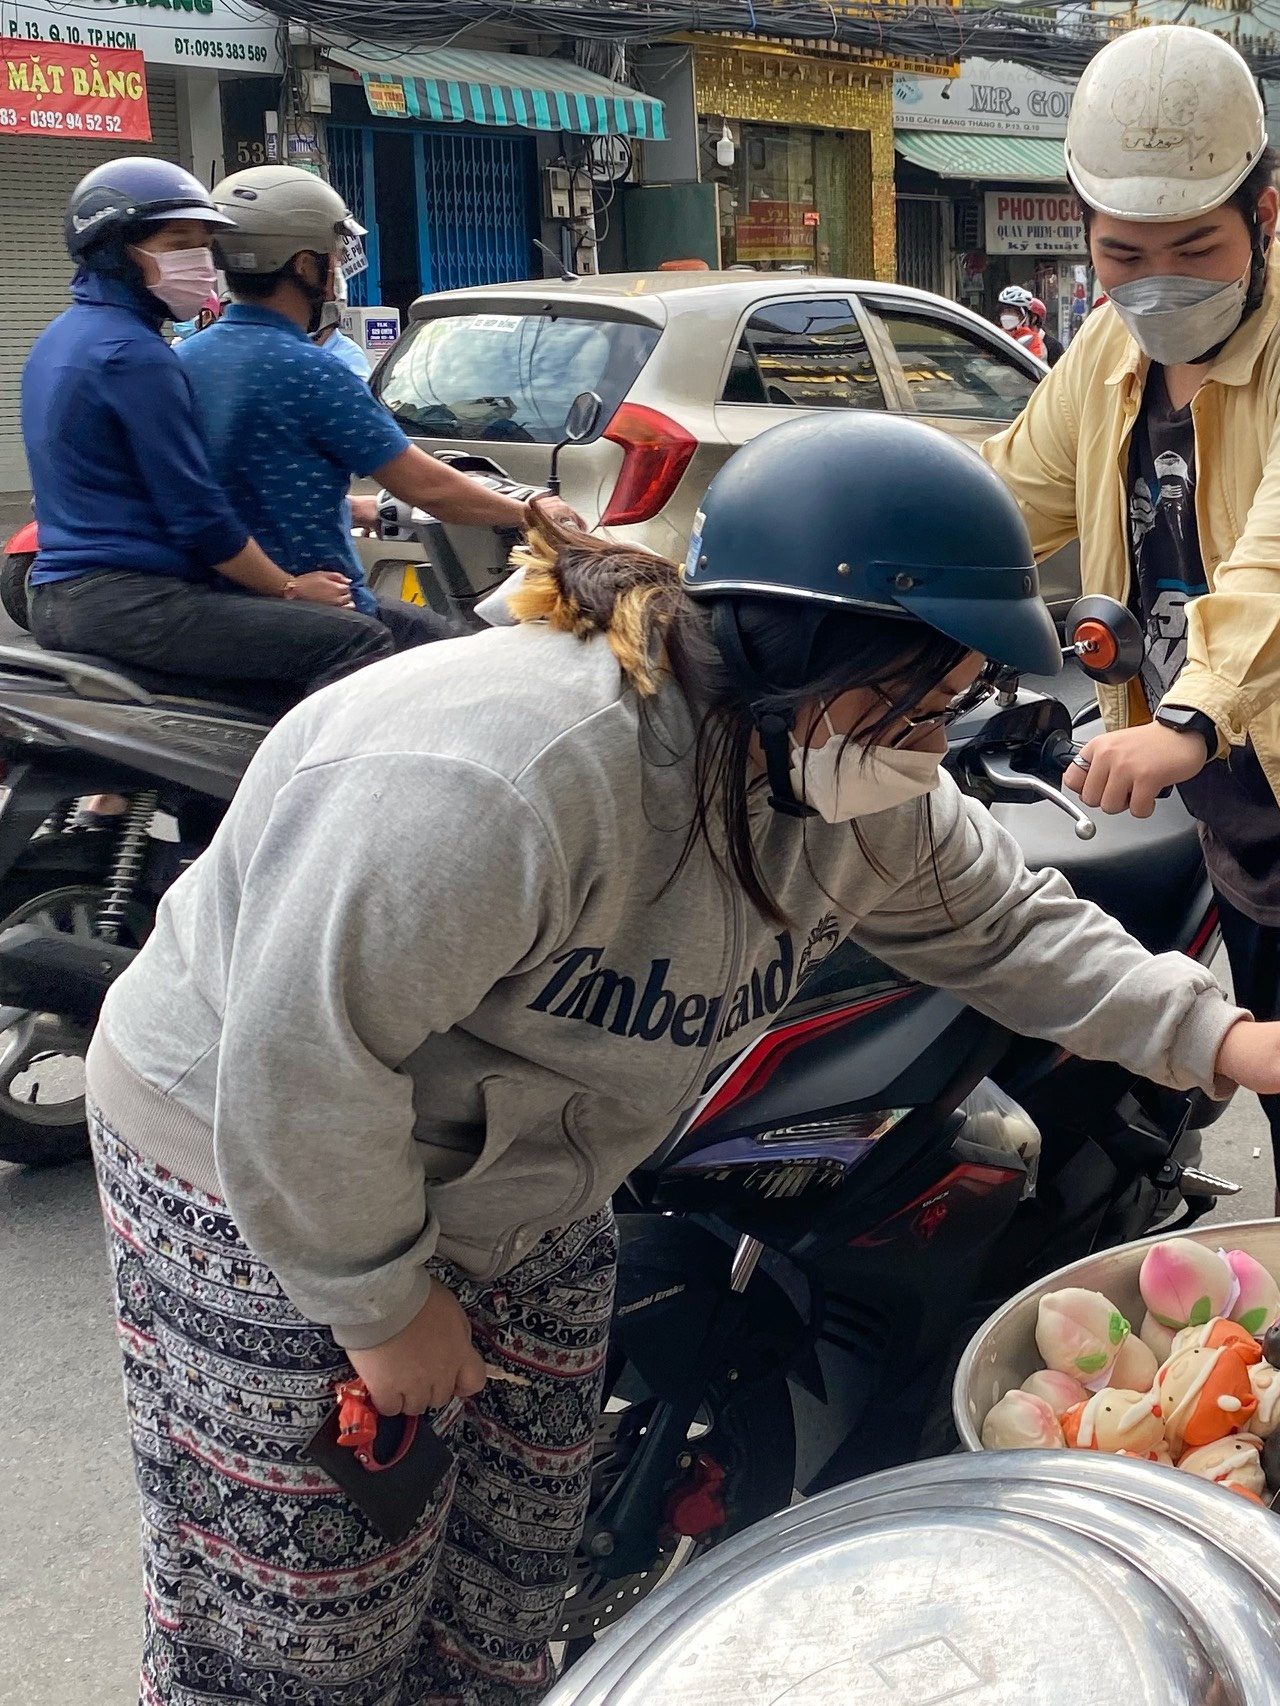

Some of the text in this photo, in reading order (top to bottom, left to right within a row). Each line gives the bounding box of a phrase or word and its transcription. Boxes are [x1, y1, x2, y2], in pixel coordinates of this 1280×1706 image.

[87, 28, 137, 49] TP.HCM
[225, 43, 246, 60] 383
[247, 45, 268, 62] 589
[7, 53, 144, 101] MẶT BẰNG
[969, 84, 1020, 117] MR.
[30, 110, 63, 129] 0392
[65, 112, 83, 130] 94
[86, 113, 103, 131] 52
[105, 115, 122, 133] 52
[895, 115, 914, 123] 531B
[997, 225, 1024, 240] QUAY
